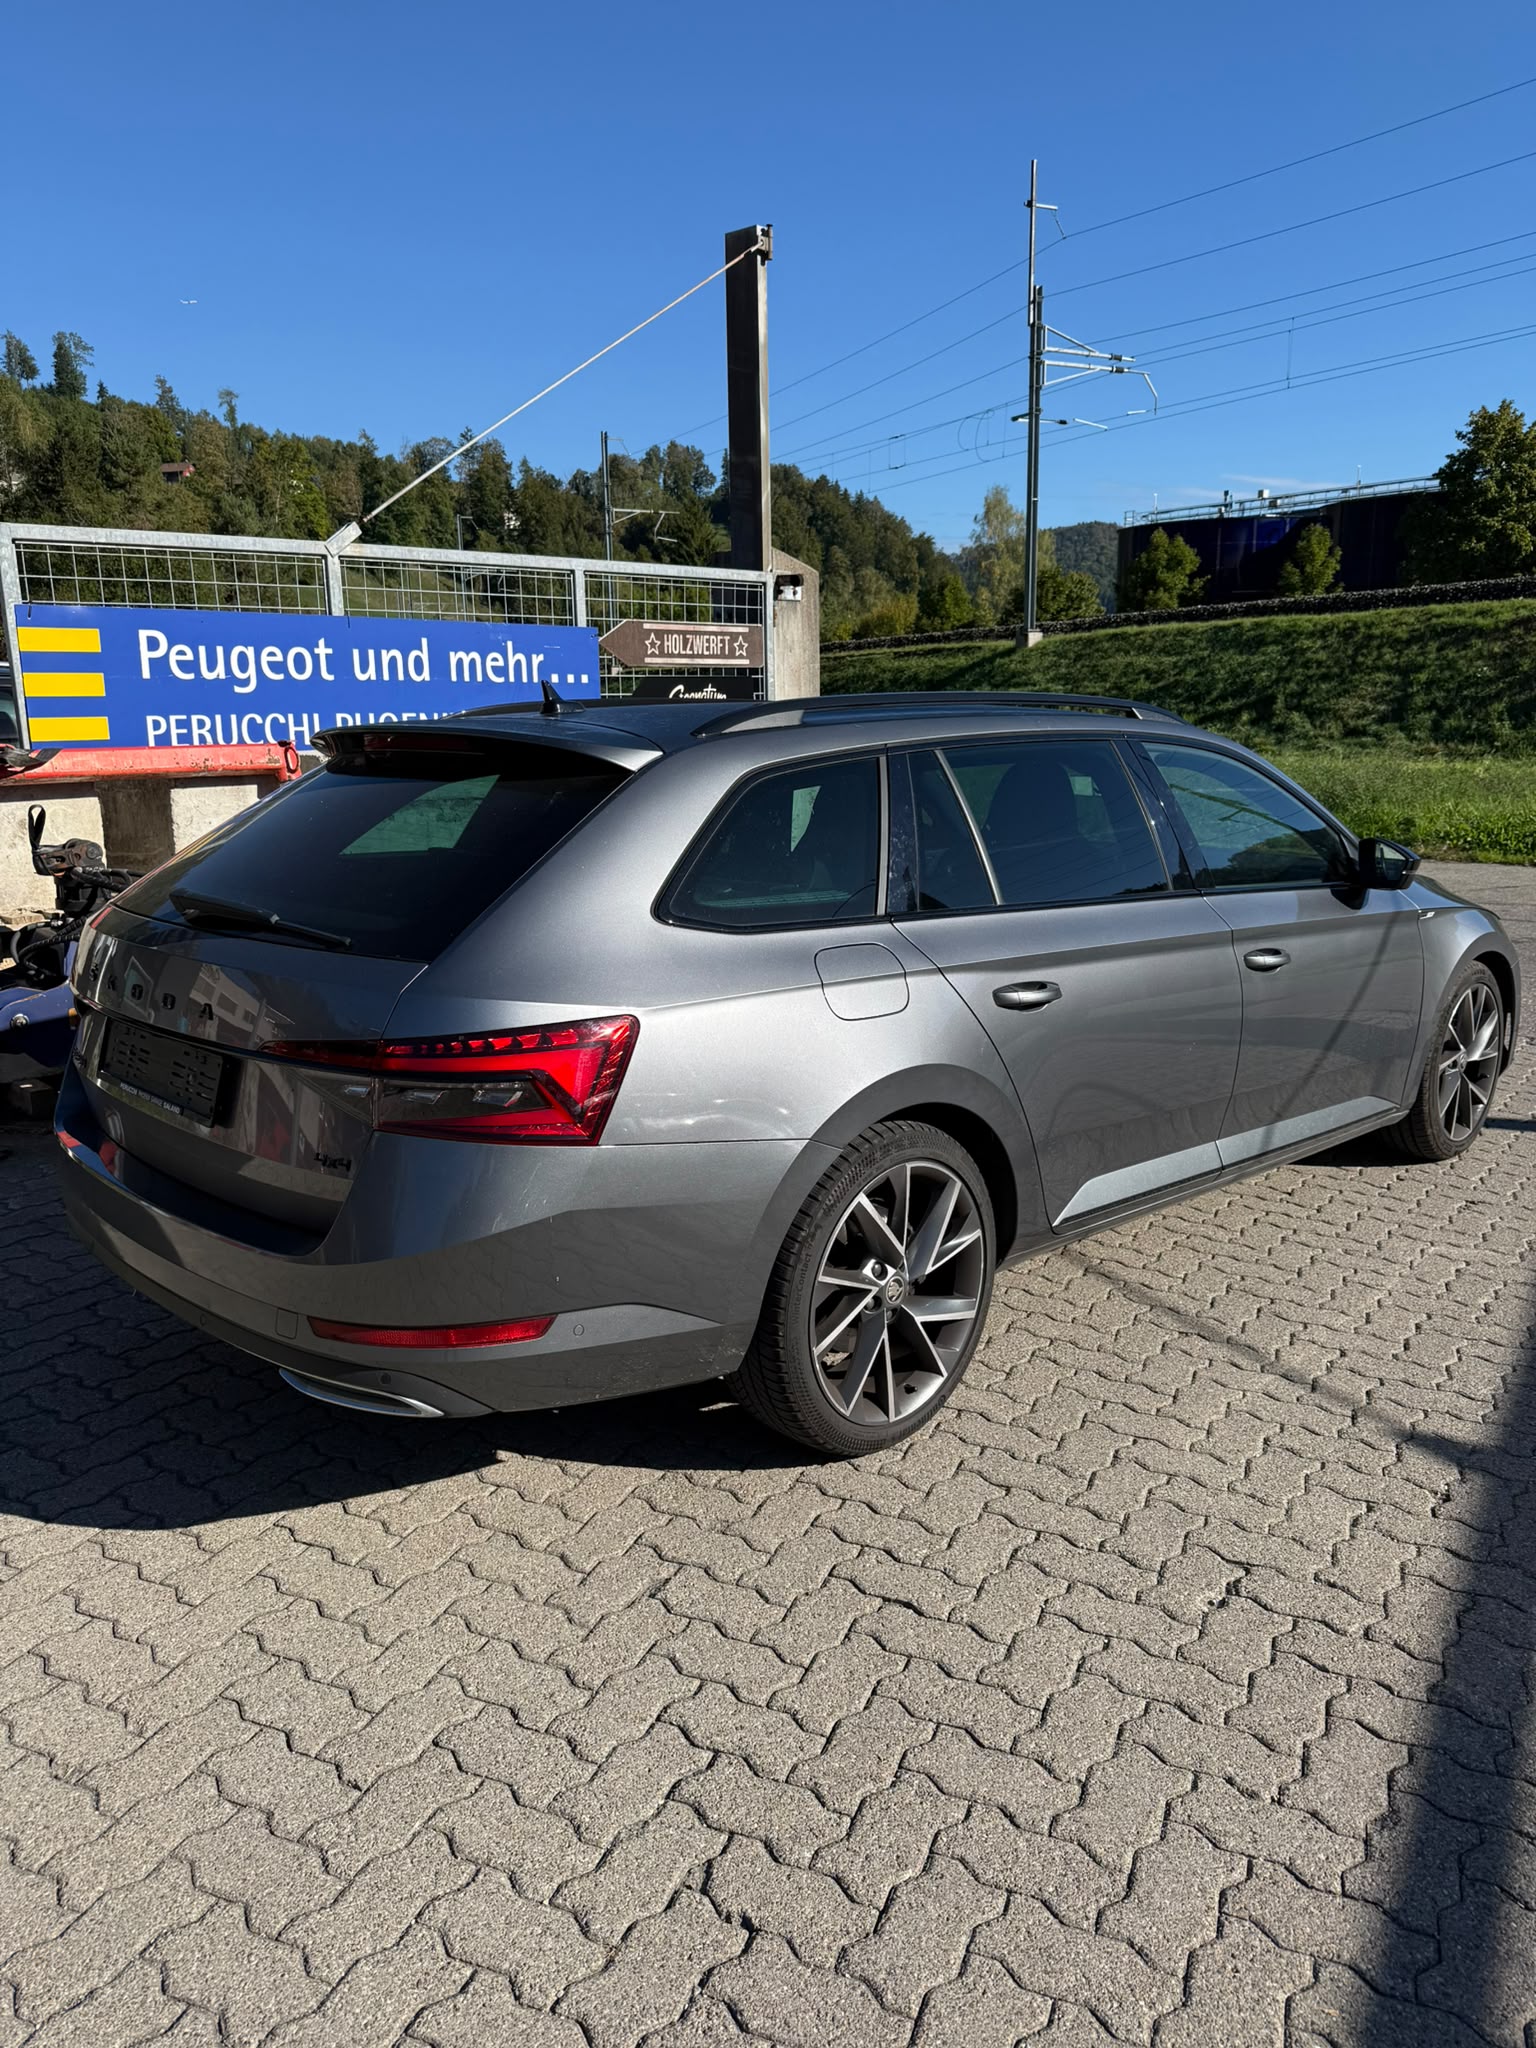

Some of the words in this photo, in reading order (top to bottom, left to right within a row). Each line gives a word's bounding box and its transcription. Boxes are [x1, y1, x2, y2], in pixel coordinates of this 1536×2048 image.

[138, 628, 335, 694] Peugeot
[352, 637, 431, 682] und
[664, 634, 730, 655] HOLZWERFT
[146, 713, 322, 747] PERUCCHI
